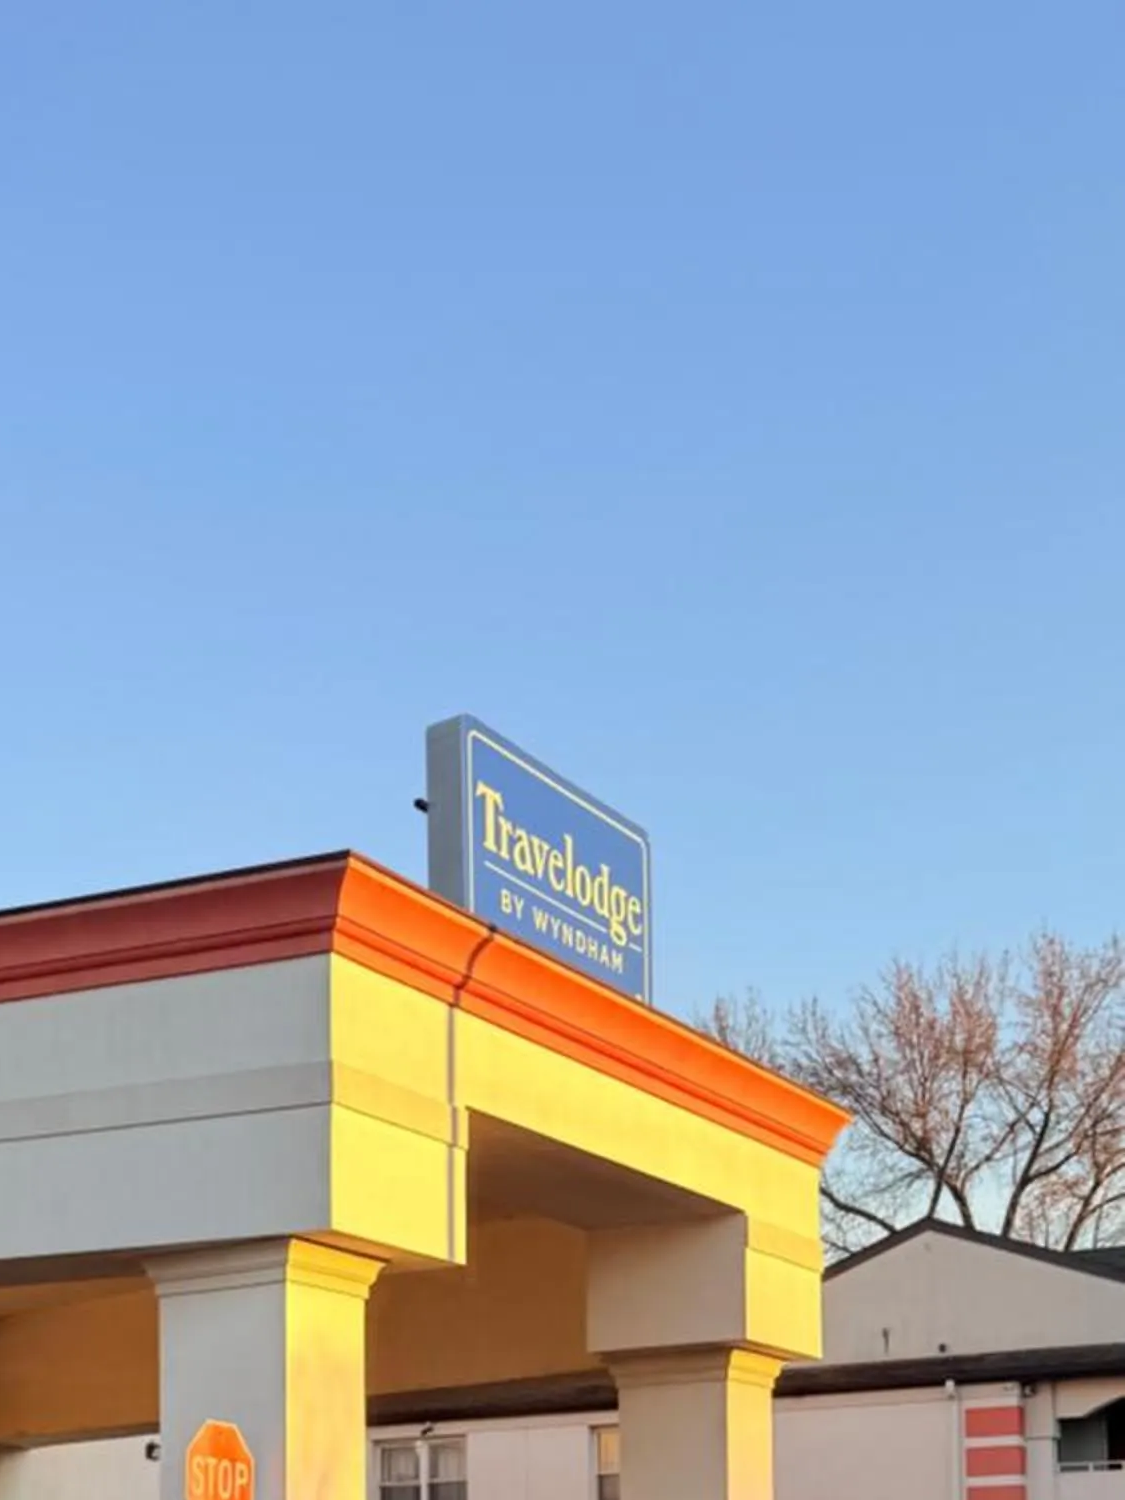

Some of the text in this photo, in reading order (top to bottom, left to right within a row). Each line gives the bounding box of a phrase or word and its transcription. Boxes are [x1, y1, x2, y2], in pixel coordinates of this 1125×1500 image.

[475, 780, 643, 946] Travelodge
[500, 888, 624, 974] BY WYNDHAM
